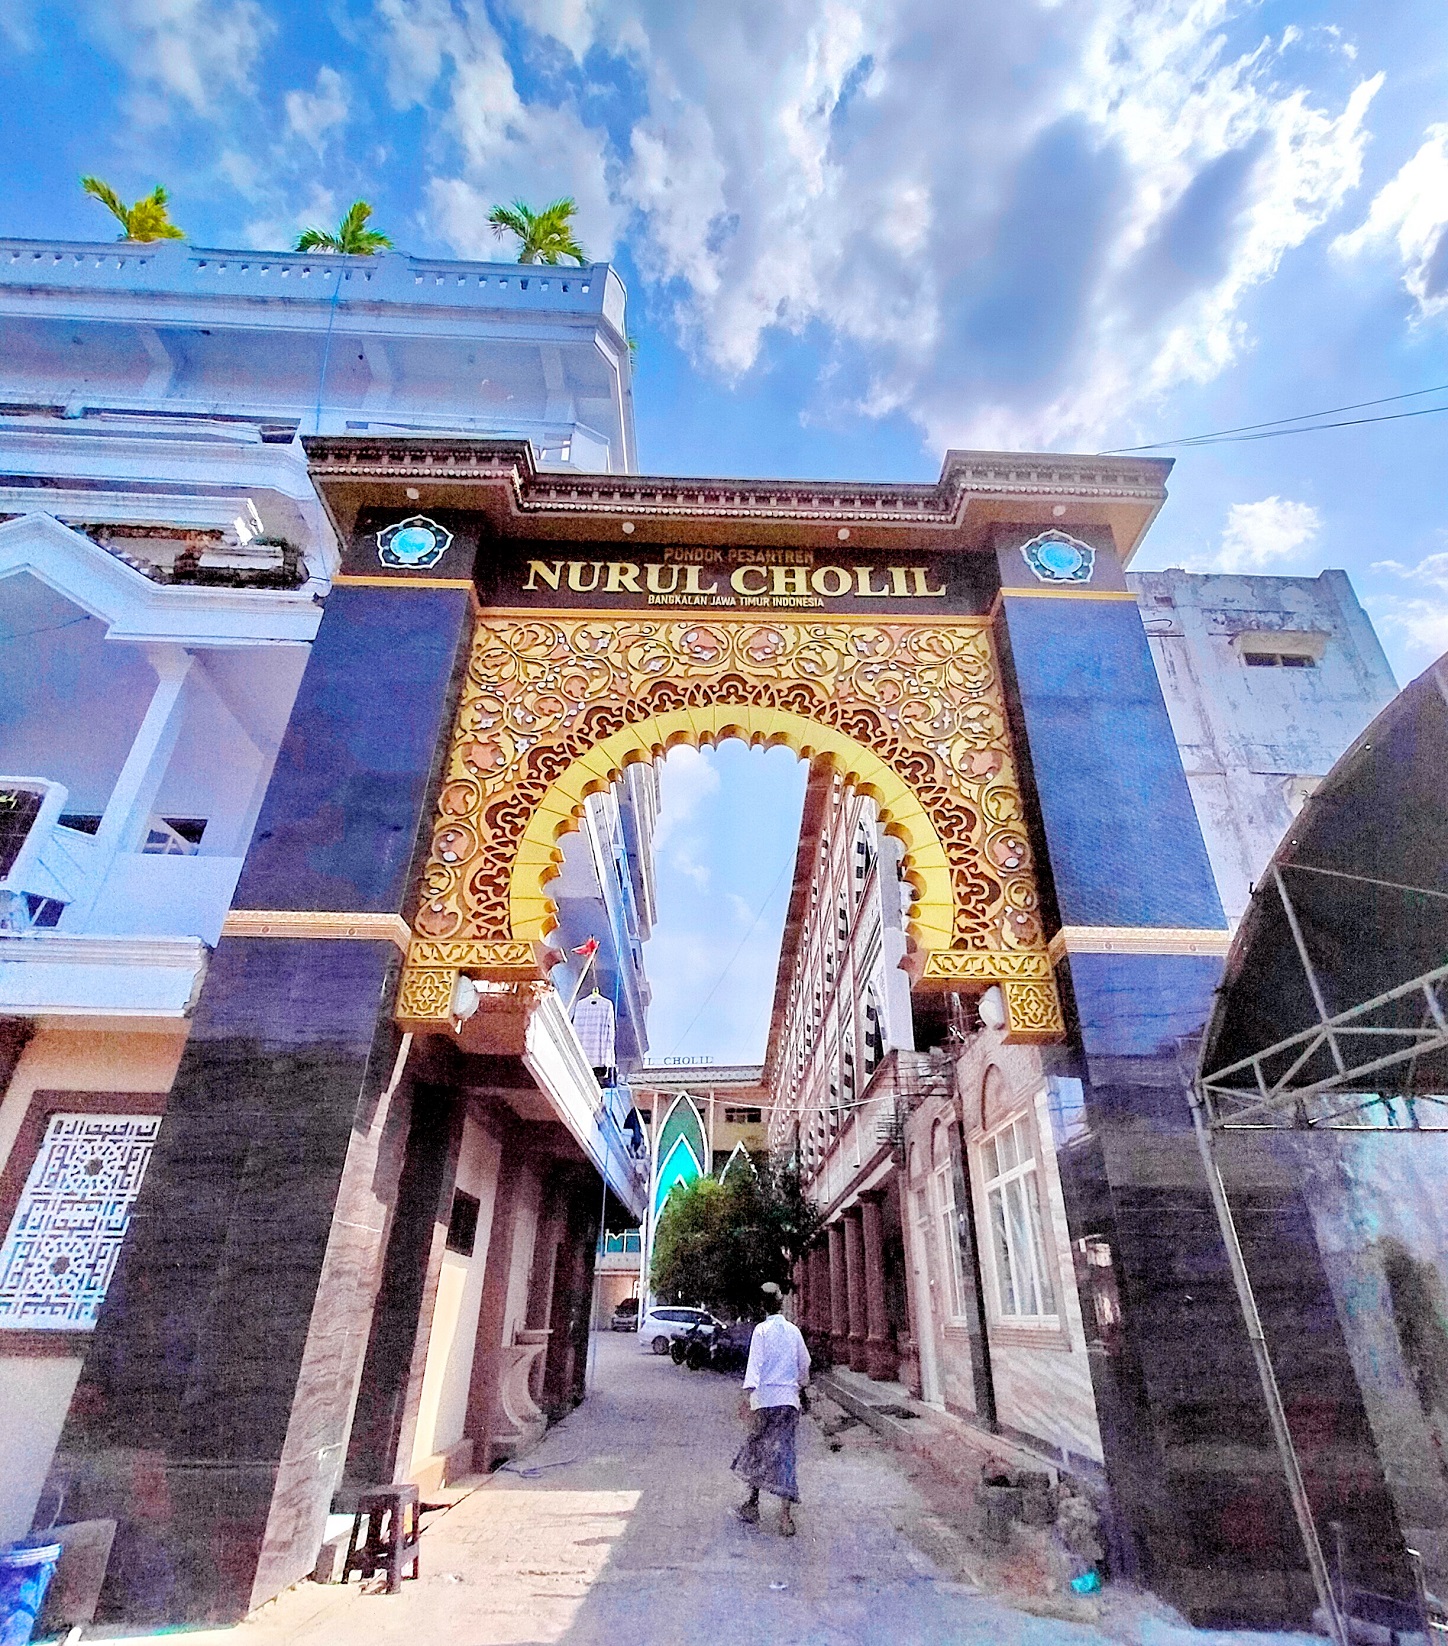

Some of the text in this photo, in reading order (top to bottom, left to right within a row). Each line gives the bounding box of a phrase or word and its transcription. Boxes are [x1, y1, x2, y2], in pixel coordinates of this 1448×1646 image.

[664, 548, 814, 565] PONDOK PESANTREN
[522, 560, 947, 598] NURUL CHOLIL
[648, 594, 825, 608] BANGKALAN JAWA TIMUR INDONESIA
[663, 1056, 714, 1066] CHOLIL
